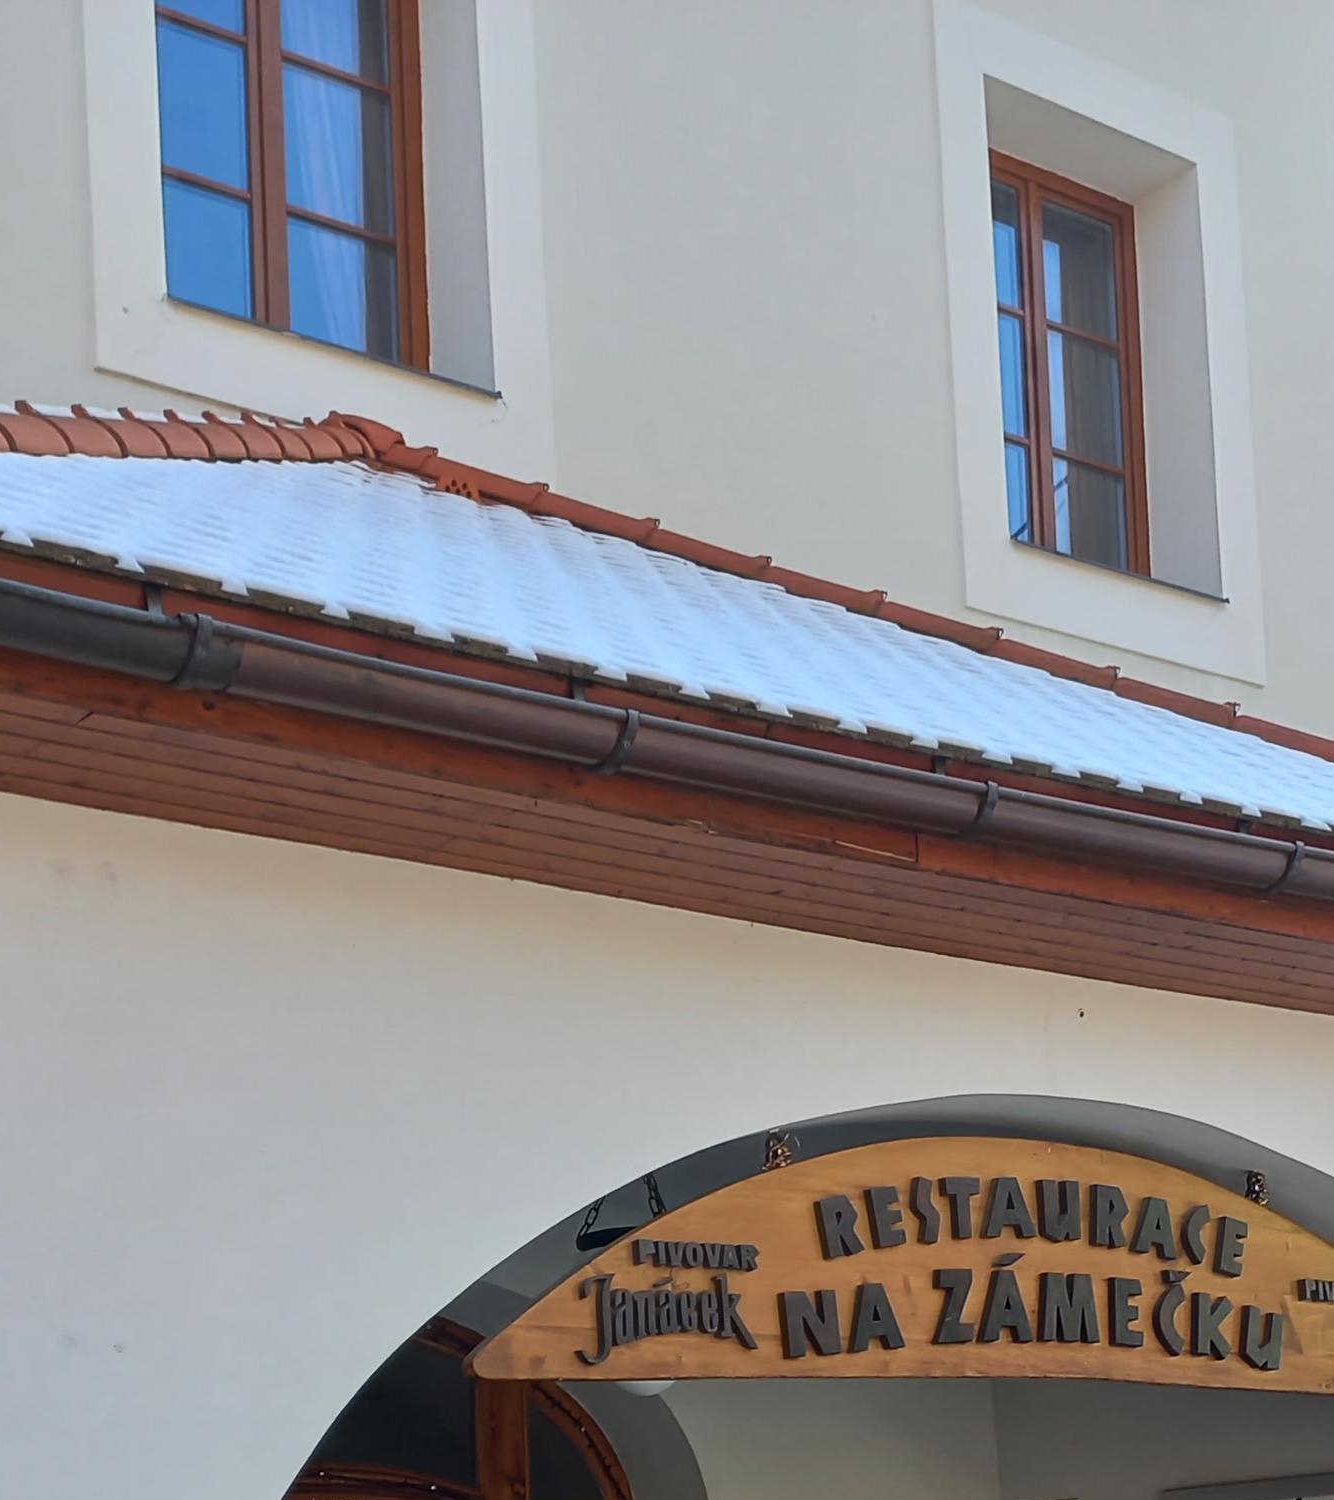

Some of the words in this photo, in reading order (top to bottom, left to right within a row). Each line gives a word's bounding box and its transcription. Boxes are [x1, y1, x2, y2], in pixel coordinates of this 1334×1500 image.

[632, 1239, 759, 1271] PIVOVAR
[813, 1176, 1248, 1277] RESTAURACE
[777, 1283, 906, 1359] NA
[932, 1252, 1283, 1370] ZÁMEČKU
